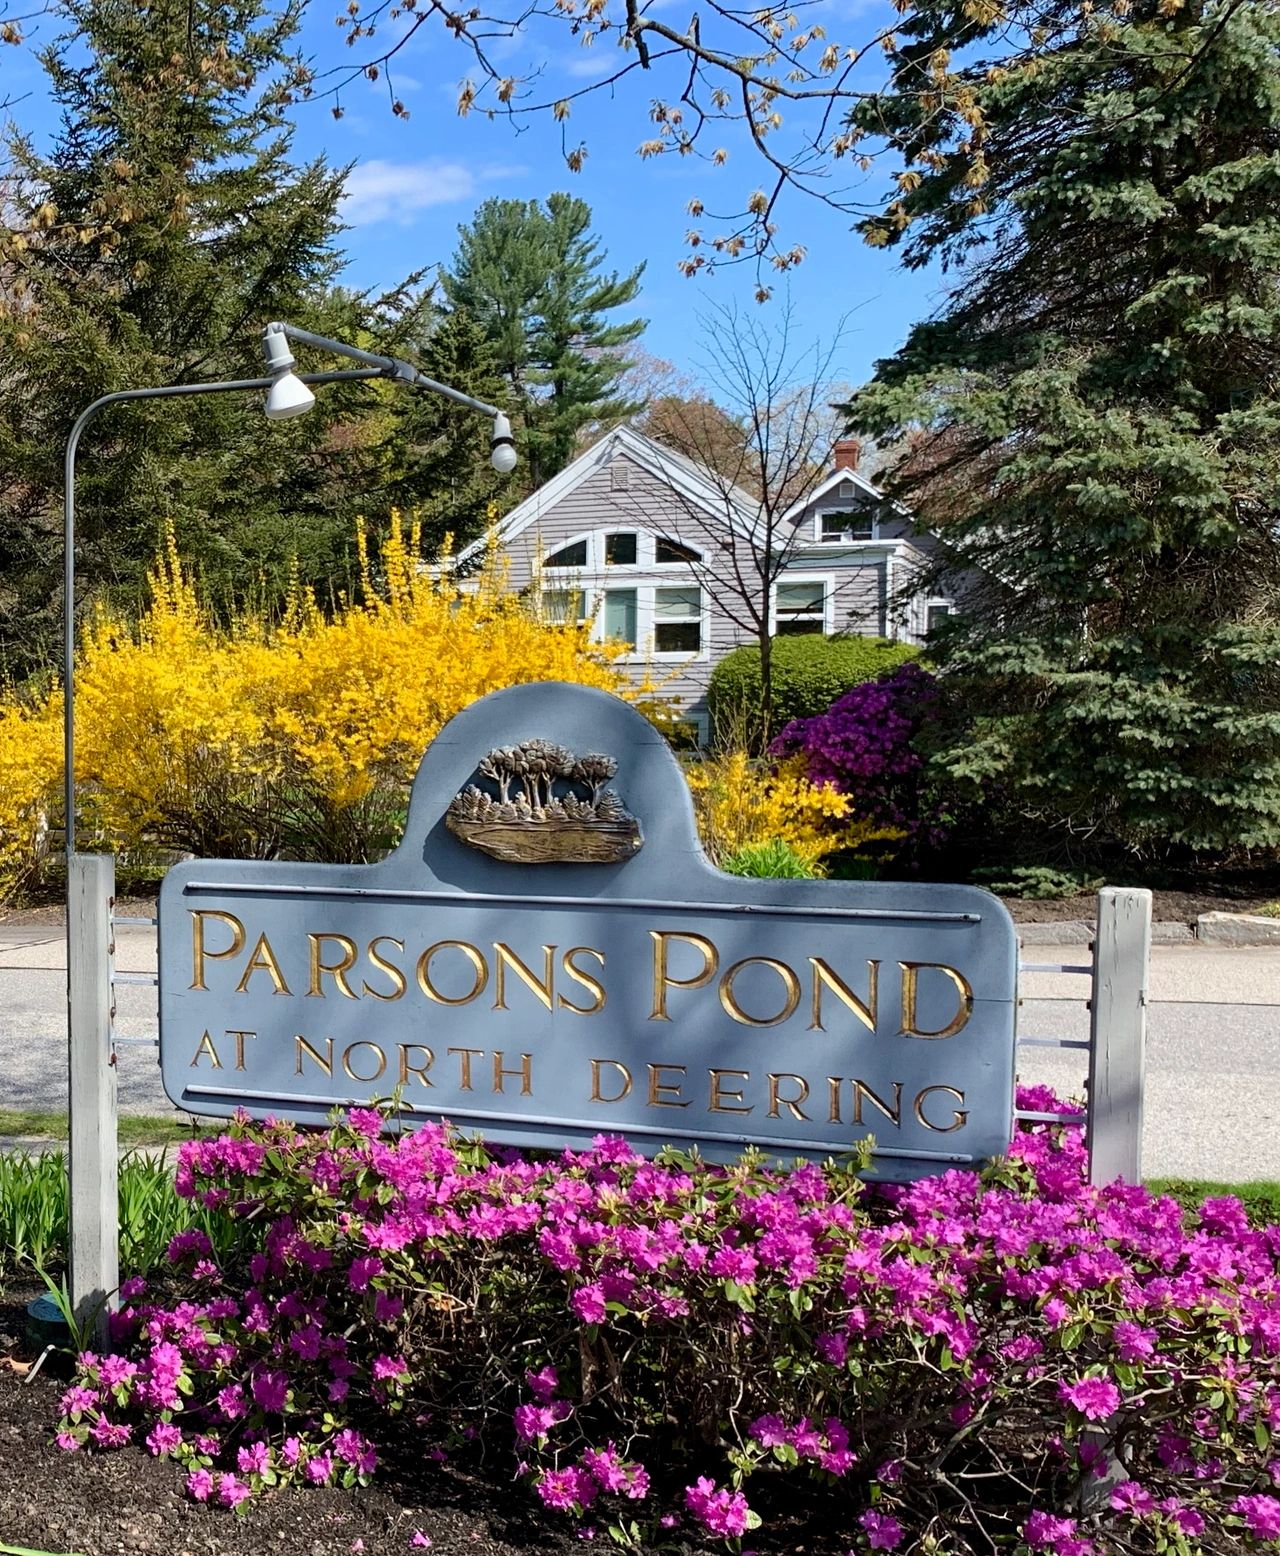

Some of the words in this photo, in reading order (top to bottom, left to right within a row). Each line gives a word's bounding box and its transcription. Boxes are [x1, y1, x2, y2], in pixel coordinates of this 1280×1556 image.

[187, 908, 607, 1016] PARSONS
[646, 930, 974, 1040] POND
[189, 1029, 258, 1071] AT
[294, 1034, 533, 1097] NORTH
[588, 1058, 969, 1133] DEERING
